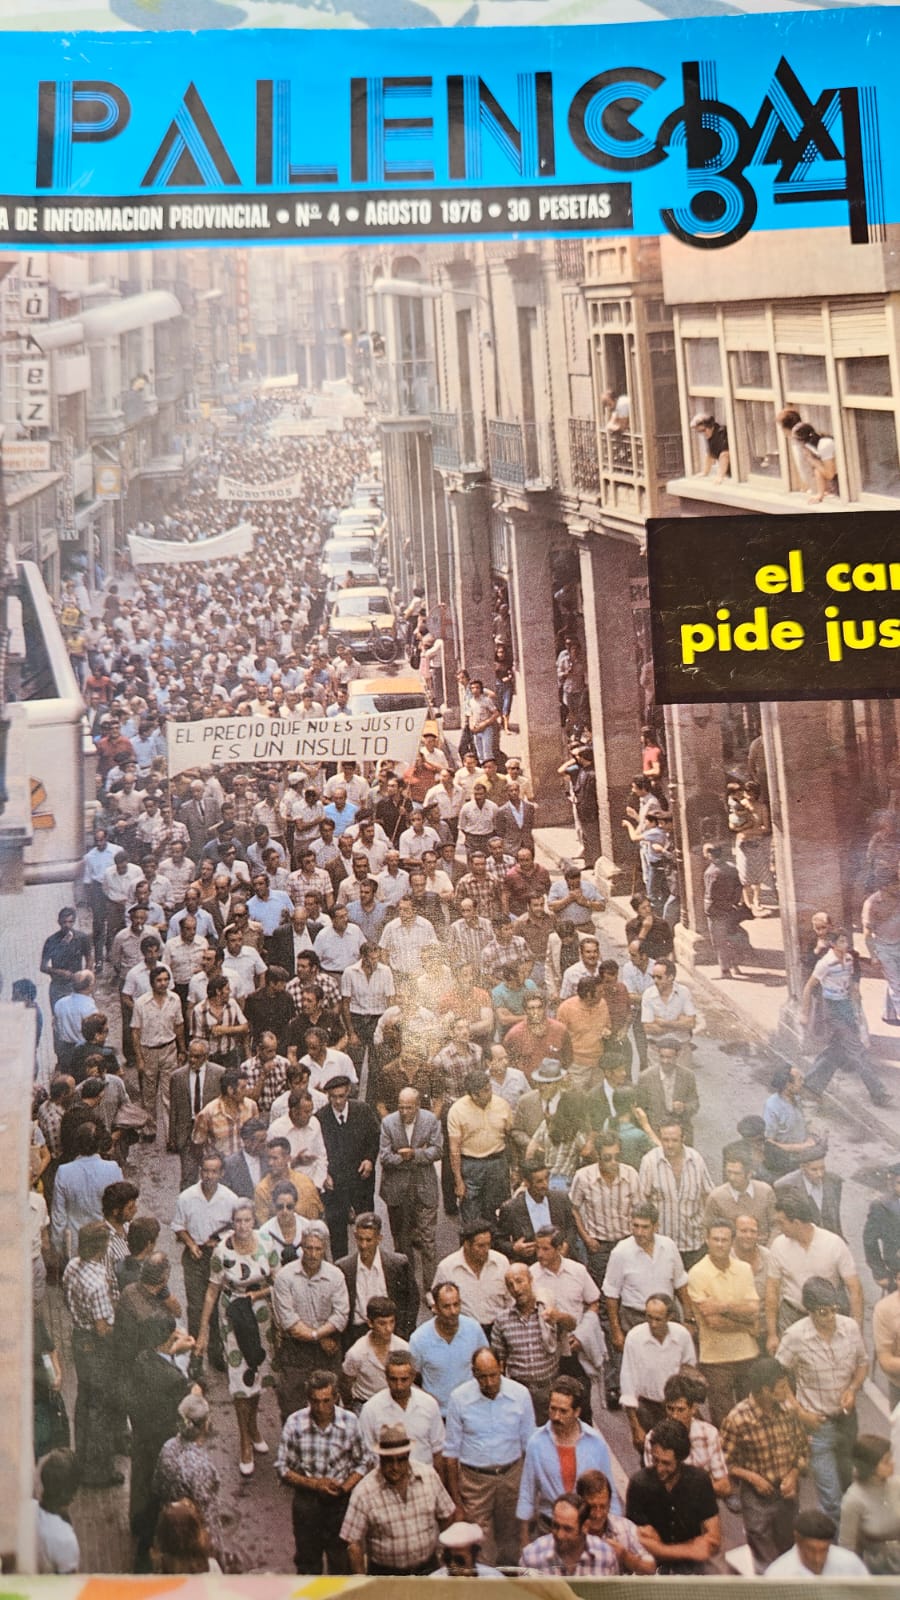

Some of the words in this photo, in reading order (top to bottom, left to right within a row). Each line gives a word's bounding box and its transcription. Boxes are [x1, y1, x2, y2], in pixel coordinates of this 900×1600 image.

[36, 55, 843, 189] PALENCIA
[656, 86, 886, 250] 34
[15, 207, 38, 231] DE
[43, 206, 163, 231] INFORMACION
[169, 203, 270, 229] PROVINCIAL
[327, 203, 340, 225] 4
[365, 199, 432, 225] AGOSTO
[440, 199, 483, 224] 1976
[507, 197, 530, 222] 30
[538, 193, 611, 220] PESETAS
[228, 487, 293, 498] NOSOTROS
[755, 549, 804, 594] el
[825, 562, 900, 592] ca
[680, 606, 805, 665] pide
[824, 605, 900, 662] jus
[175, 728, 195, 744] EL
[202, 722, 265, 742] PRECIO
[270, 720, 300, 737] QUE
[333, 720, 353, 733] ES
[361, 716, 415, 733] JUSTO
[211, 743, 241, 760] ES
[253, 738, 283, 758] UN
[295, 736, 389, 757] INSULTO
